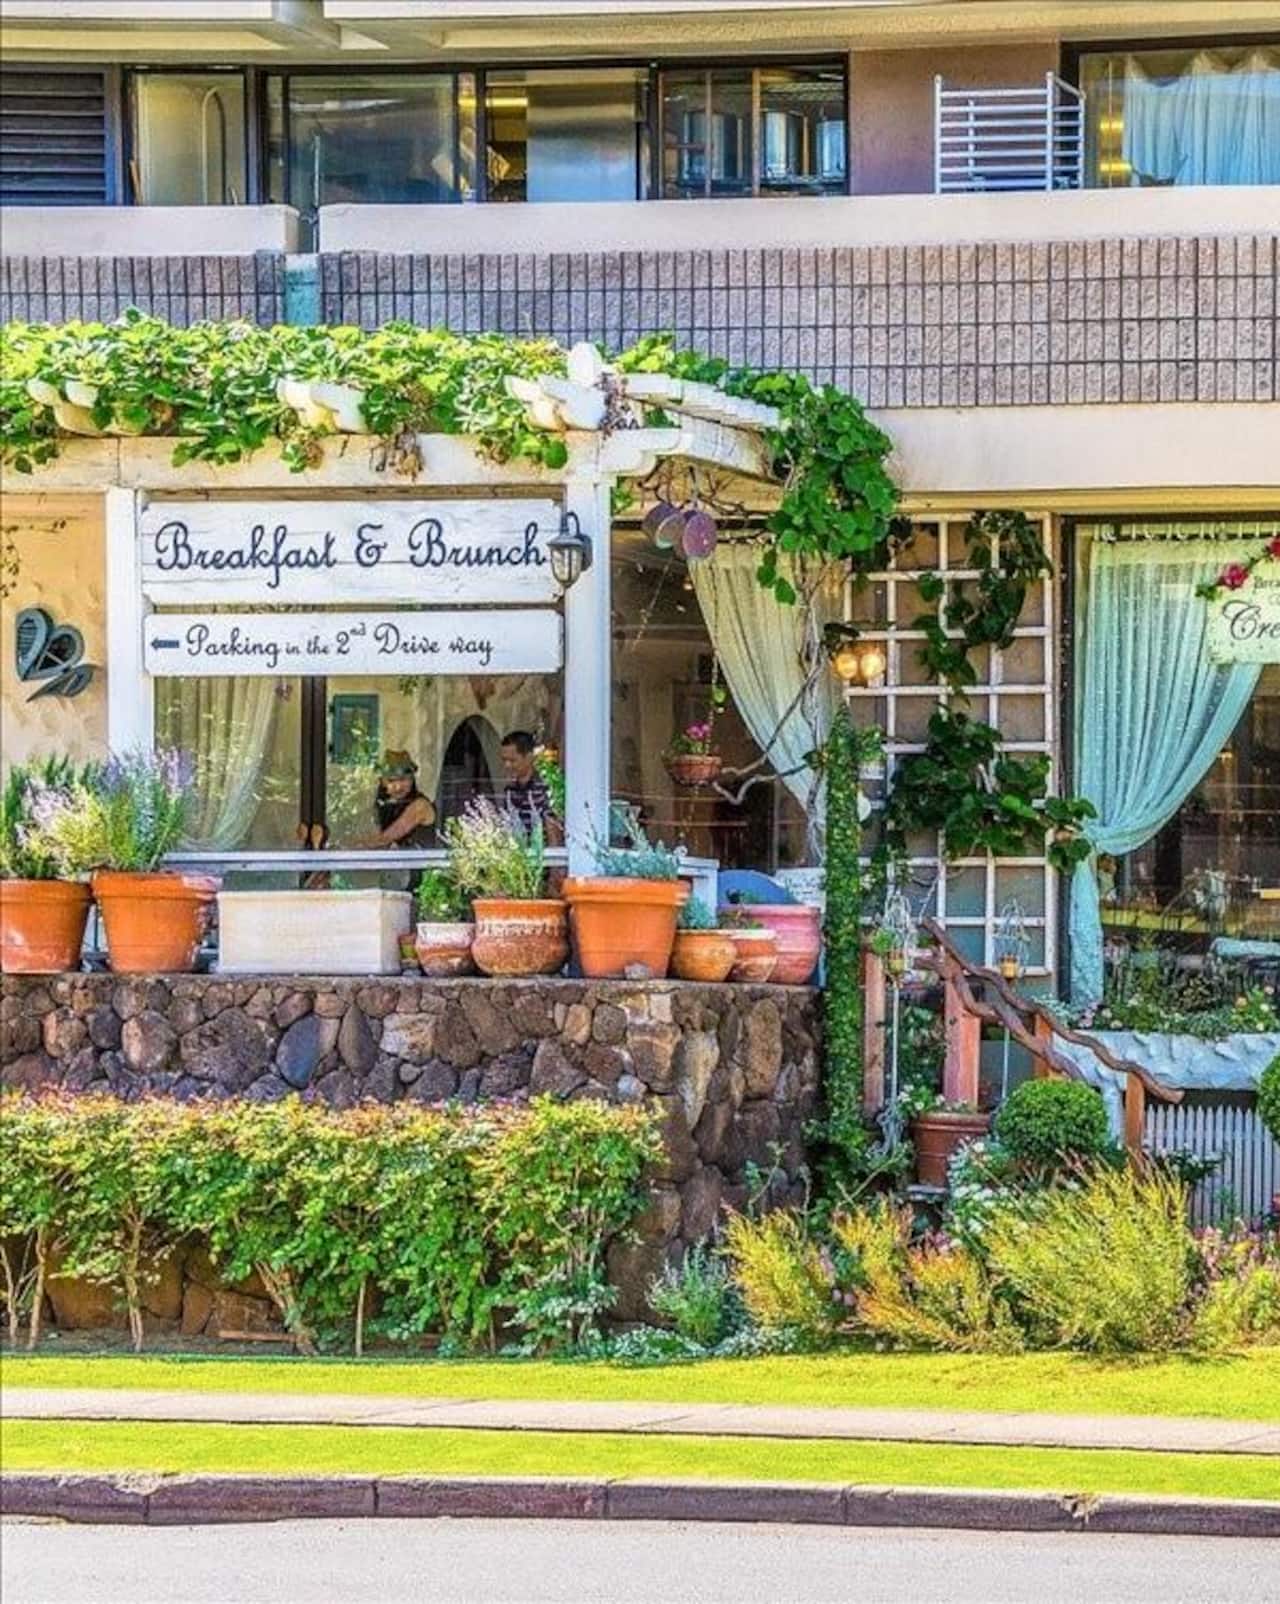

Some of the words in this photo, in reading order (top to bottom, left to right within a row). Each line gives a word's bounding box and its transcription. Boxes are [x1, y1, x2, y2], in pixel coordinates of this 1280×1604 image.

[154, 520, 338, 588] Breakfast
[354, 523, 388, 567] &
[407, 517, 547, 569] Brunch
[185, 623, 280, 668] Parking
[285, 643, 301, 655] in
[305, 635, 329, 656] the
[335, 622, 366, 655] 2nd
[373, 622, 441, 656] Drive
[447, 638, 495, 666] way
